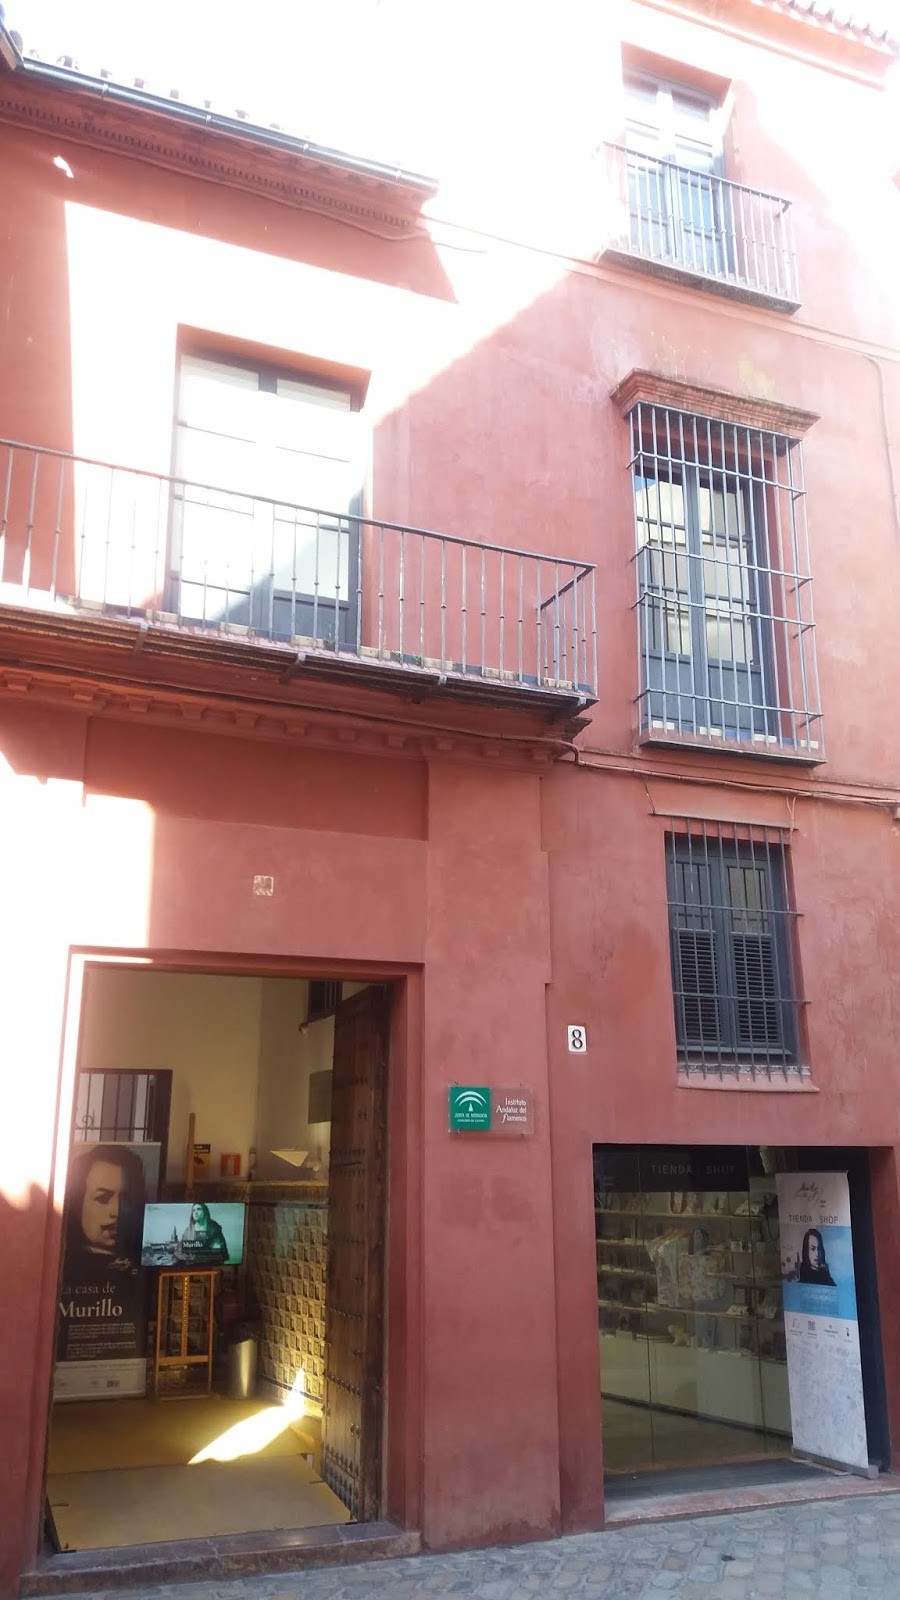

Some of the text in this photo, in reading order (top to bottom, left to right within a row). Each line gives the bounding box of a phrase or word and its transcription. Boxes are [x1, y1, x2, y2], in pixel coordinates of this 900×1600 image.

[572, 1029, 583, 1049] 8
[505, 1097, 526, 1106] Instituto
[496, 1105, 518, 1114] Andaluz
[650, 1164, 736, 1176] TIENDA SHOP
[788, 1214, 839, 1224] TIENDA SHOP
[182, 1240, 203, 1249] Murillo
[75, 1286, 99, 1294] casa
[102, 1281, 116, 1294] de
[59, 1298, 123, 1318] Murillo
